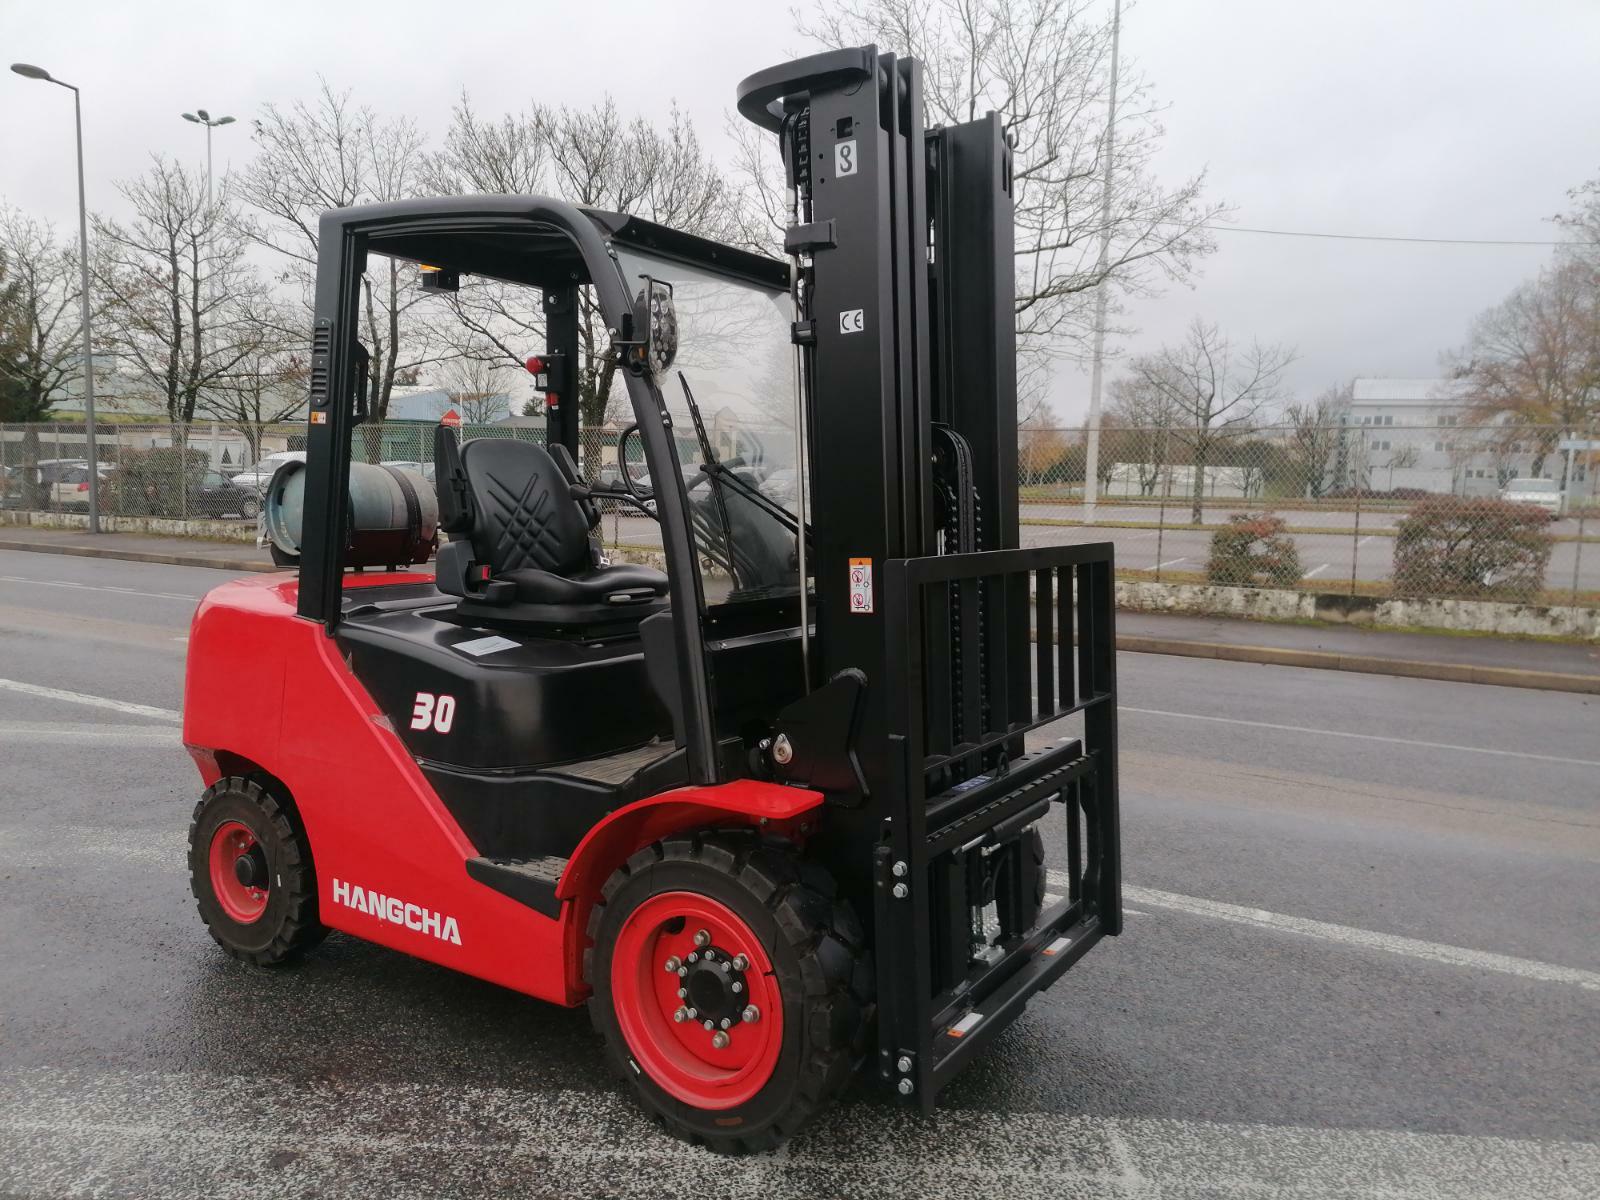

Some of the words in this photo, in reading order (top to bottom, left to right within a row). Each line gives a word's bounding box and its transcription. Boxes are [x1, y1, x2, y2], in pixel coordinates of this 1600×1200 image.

[841, 311, 862, 331] CE
[410, 692, 456, 733] 30
[333, 878, 462, 946] HANGCHA
